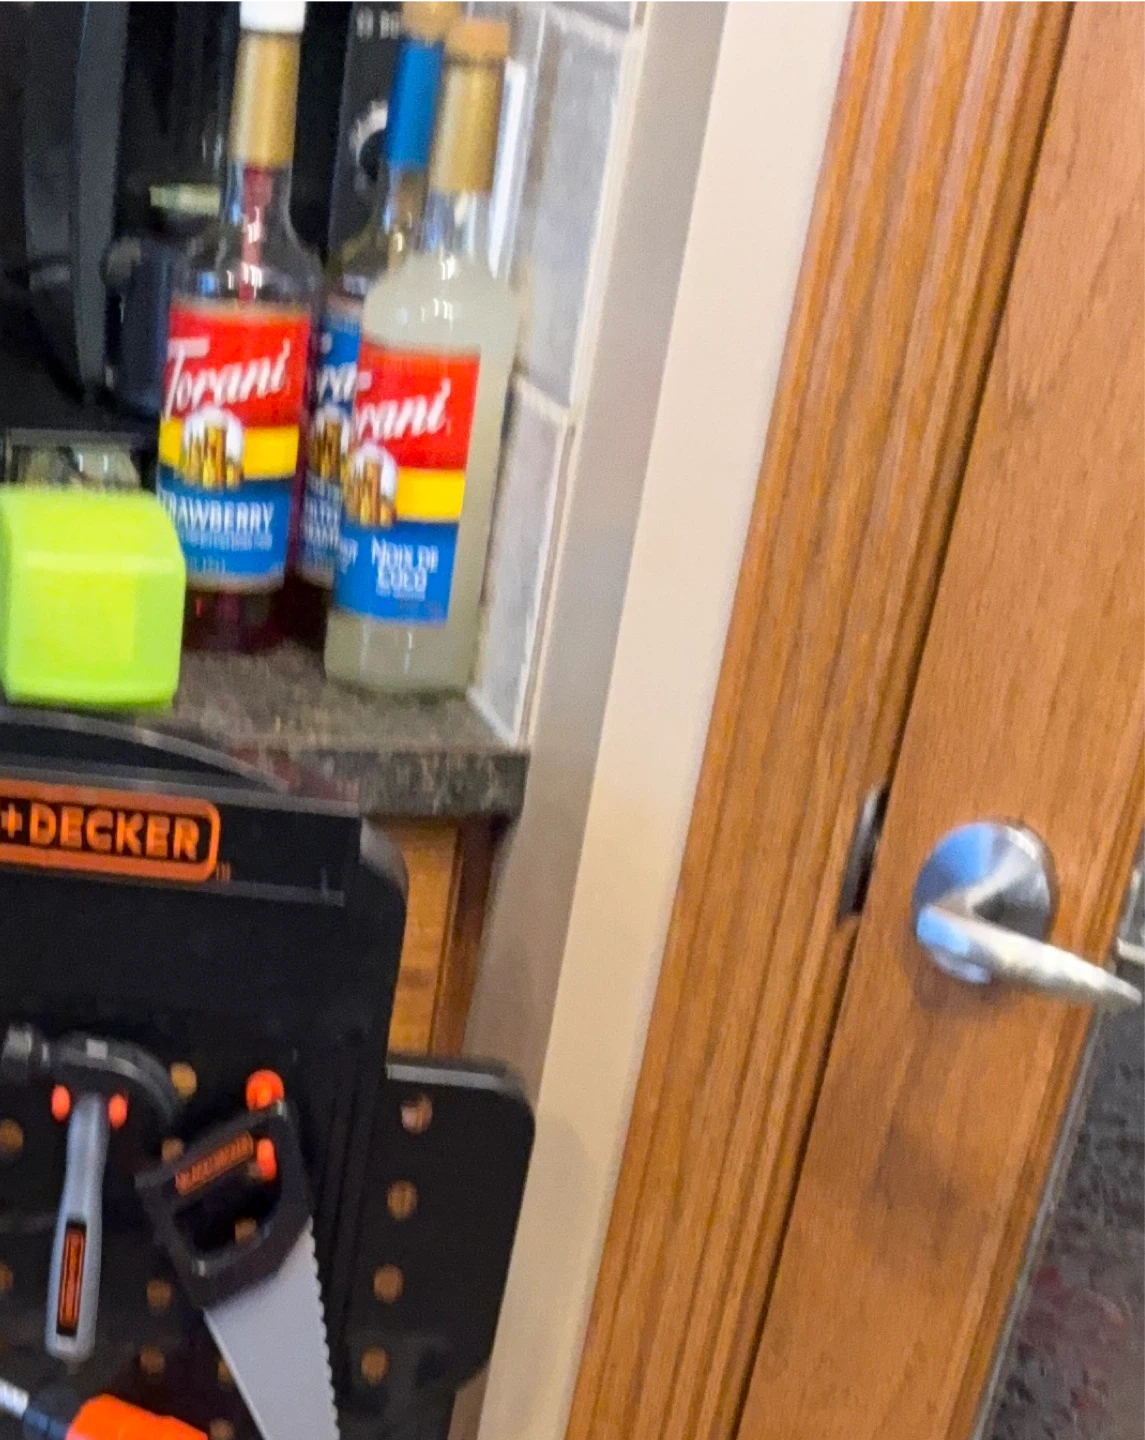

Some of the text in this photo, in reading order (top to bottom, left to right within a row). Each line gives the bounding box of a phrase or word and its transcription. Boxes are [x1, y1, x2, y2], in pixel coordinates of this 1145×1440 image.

[166, 336, 291, 421] Torani
[355, 371, 451, 440] rani
[159, 489, 274, 534] RAWBERRY
